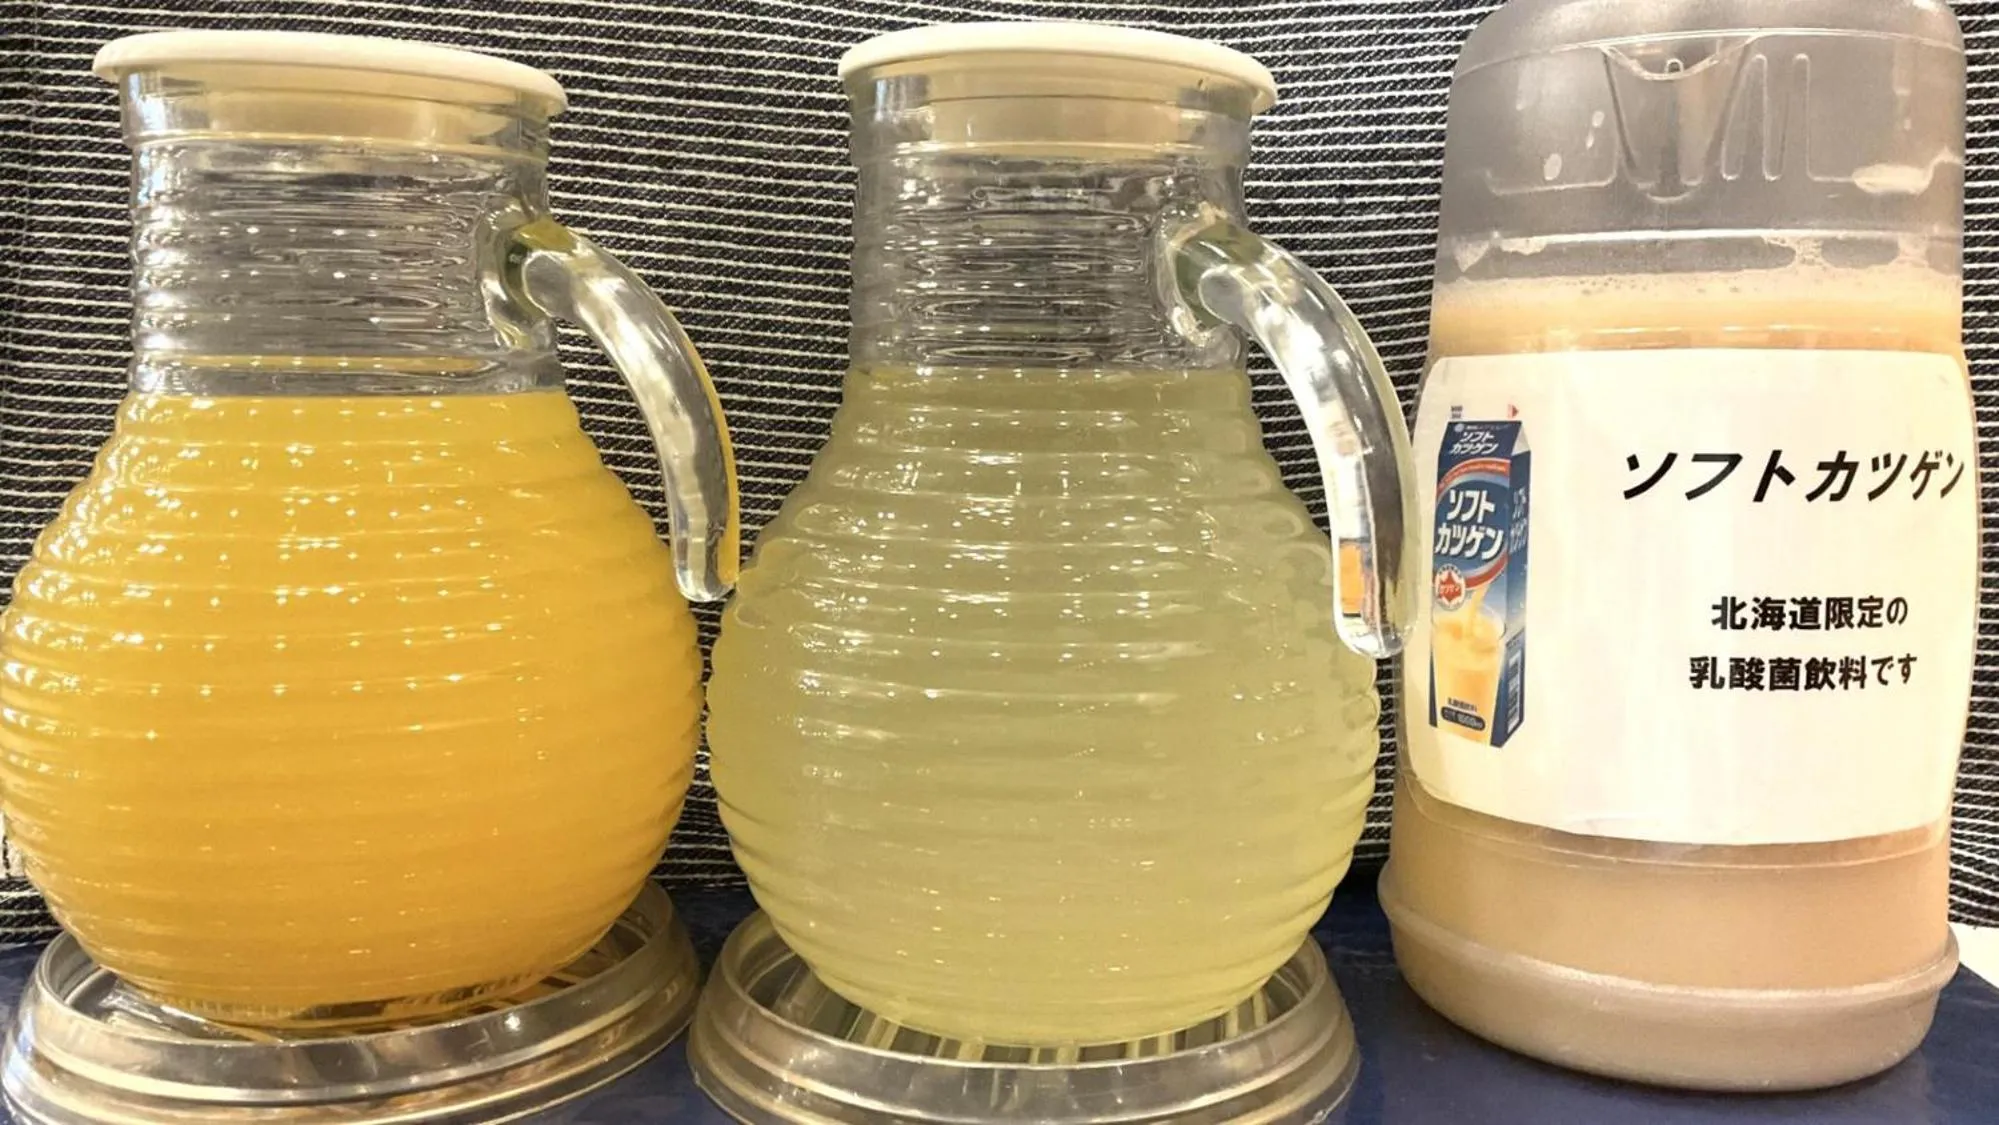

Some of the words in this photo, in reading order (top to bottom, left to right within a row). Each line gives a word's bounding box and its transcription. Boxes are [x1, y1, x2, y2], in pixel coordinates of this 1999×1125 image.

[1623, 449, 1965, 502] ソフトカツゲン
[1447, 490, 1495, 524] ソフト
[1435, 522, 1504, 560] カツゲン
[1711, 596, 1909, 631] 北海道限定の
[1689, 653, 1918, 691] 乳酸菌飲料です
